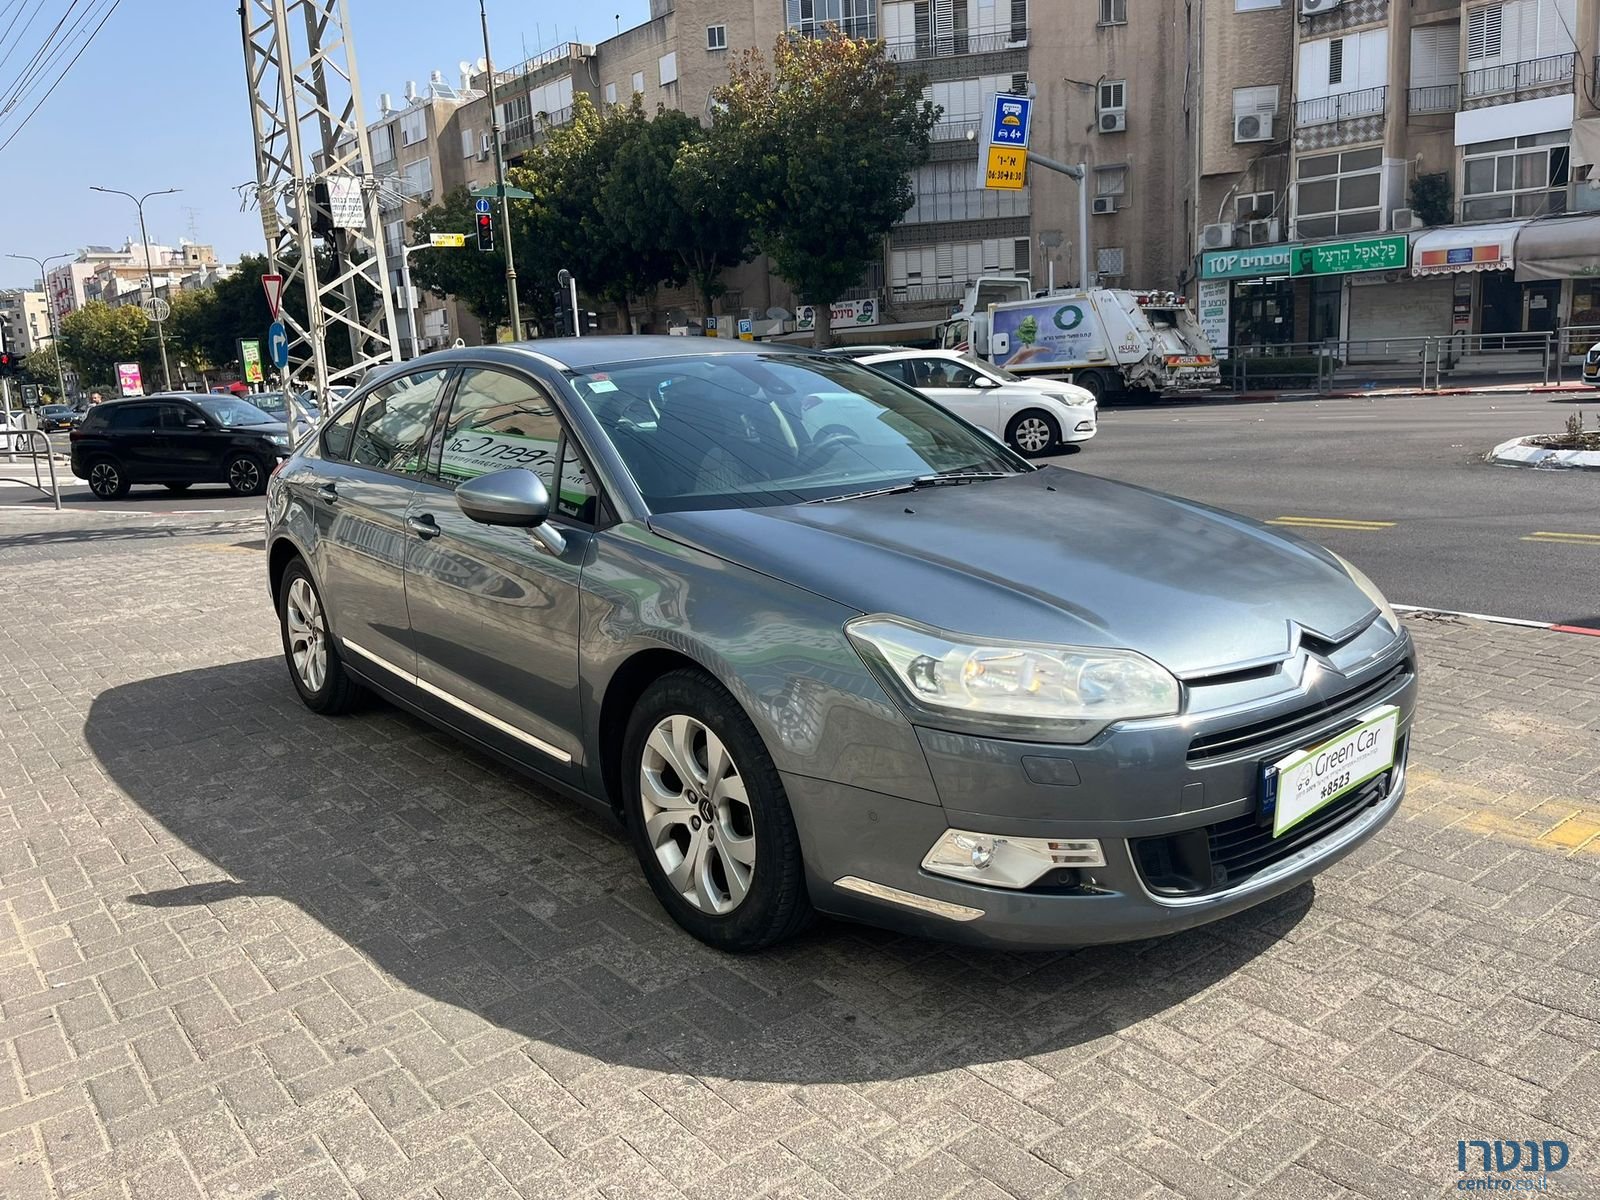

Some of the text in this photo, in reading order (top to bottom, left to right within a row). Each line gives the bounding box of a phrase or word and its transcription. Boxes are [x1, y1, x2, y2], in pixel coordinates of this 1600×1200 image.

[1009, 128, 1022, 140] 4+
[1208, 255, 1238, 274] TOP
[1315, 742, 1354, 777] Green
[1357, 728, 1381, 753] Car
